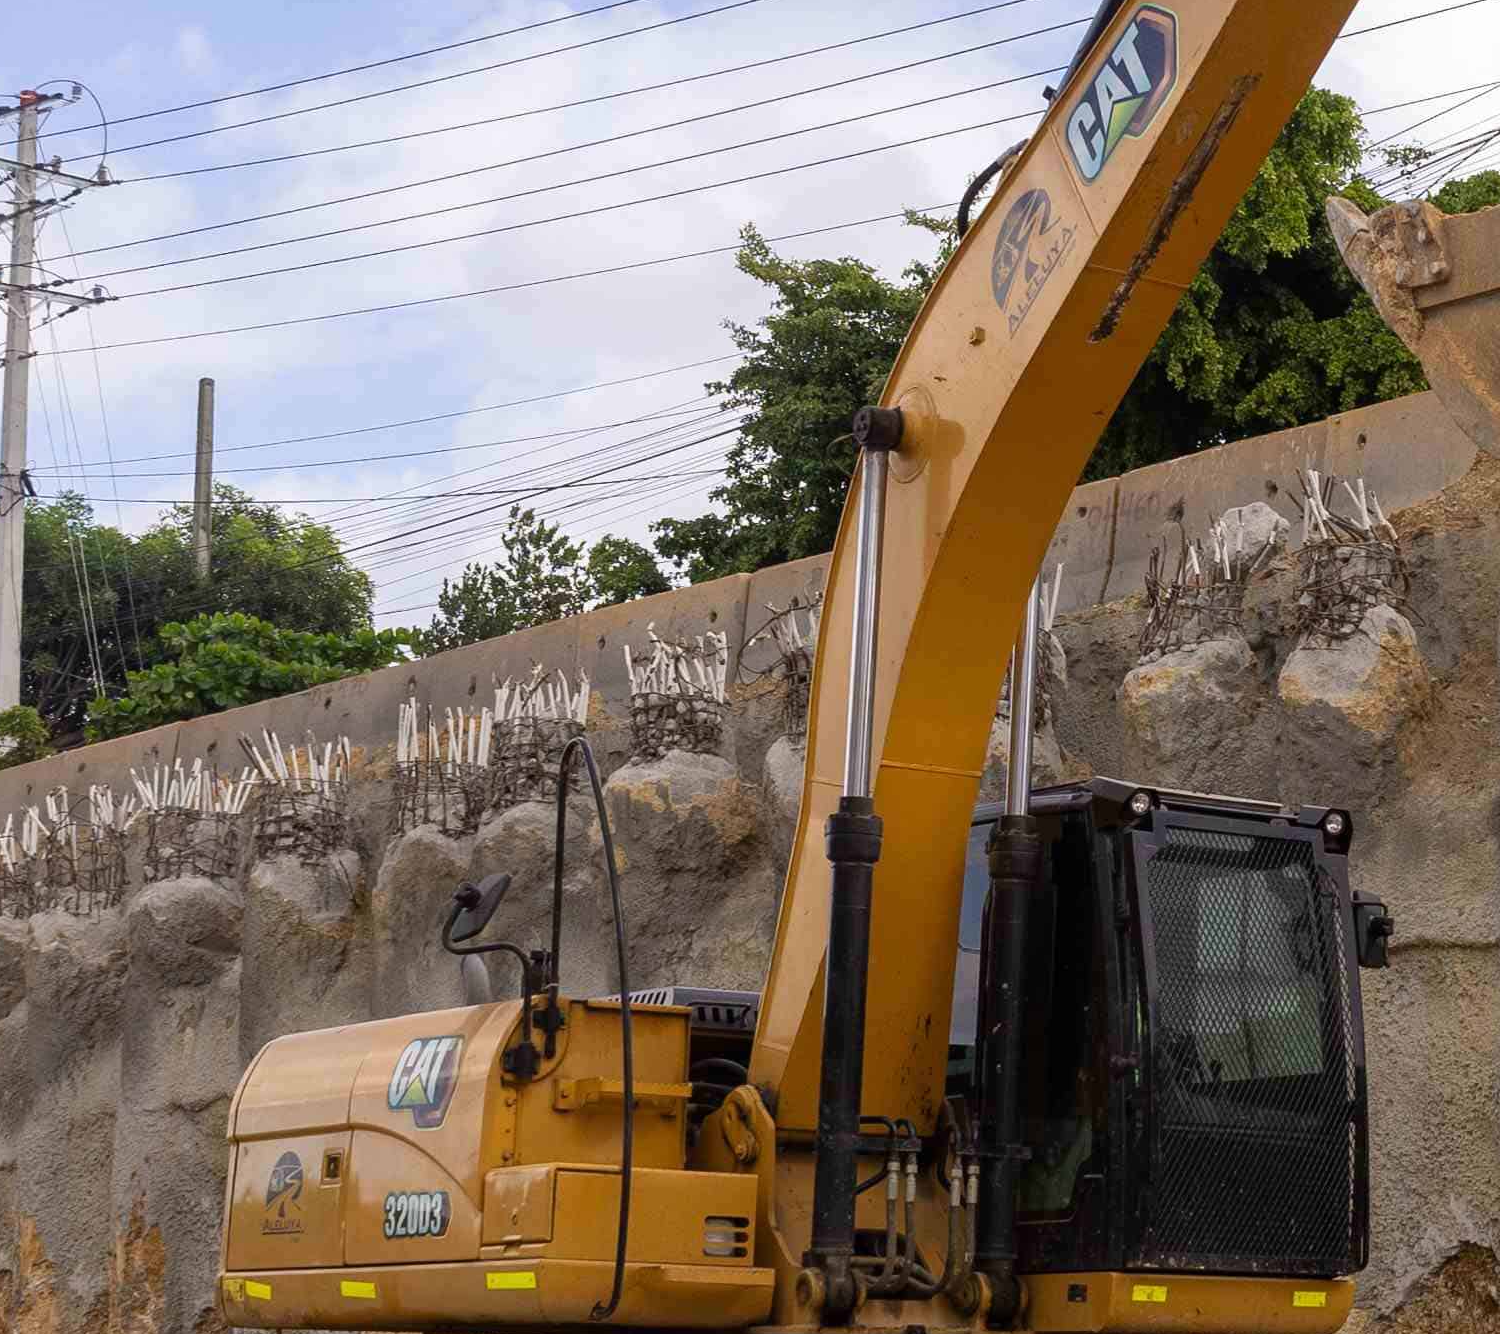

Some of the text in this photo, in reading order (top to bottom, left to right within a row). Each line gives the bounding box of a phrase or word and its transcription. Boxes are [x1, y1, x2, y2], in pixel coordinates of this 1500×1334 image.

[1067, 20, 1152, 180] CAT
[387, 1037, 459, 1107] CAT
[384, 1193, 443, 1237] 320D3
